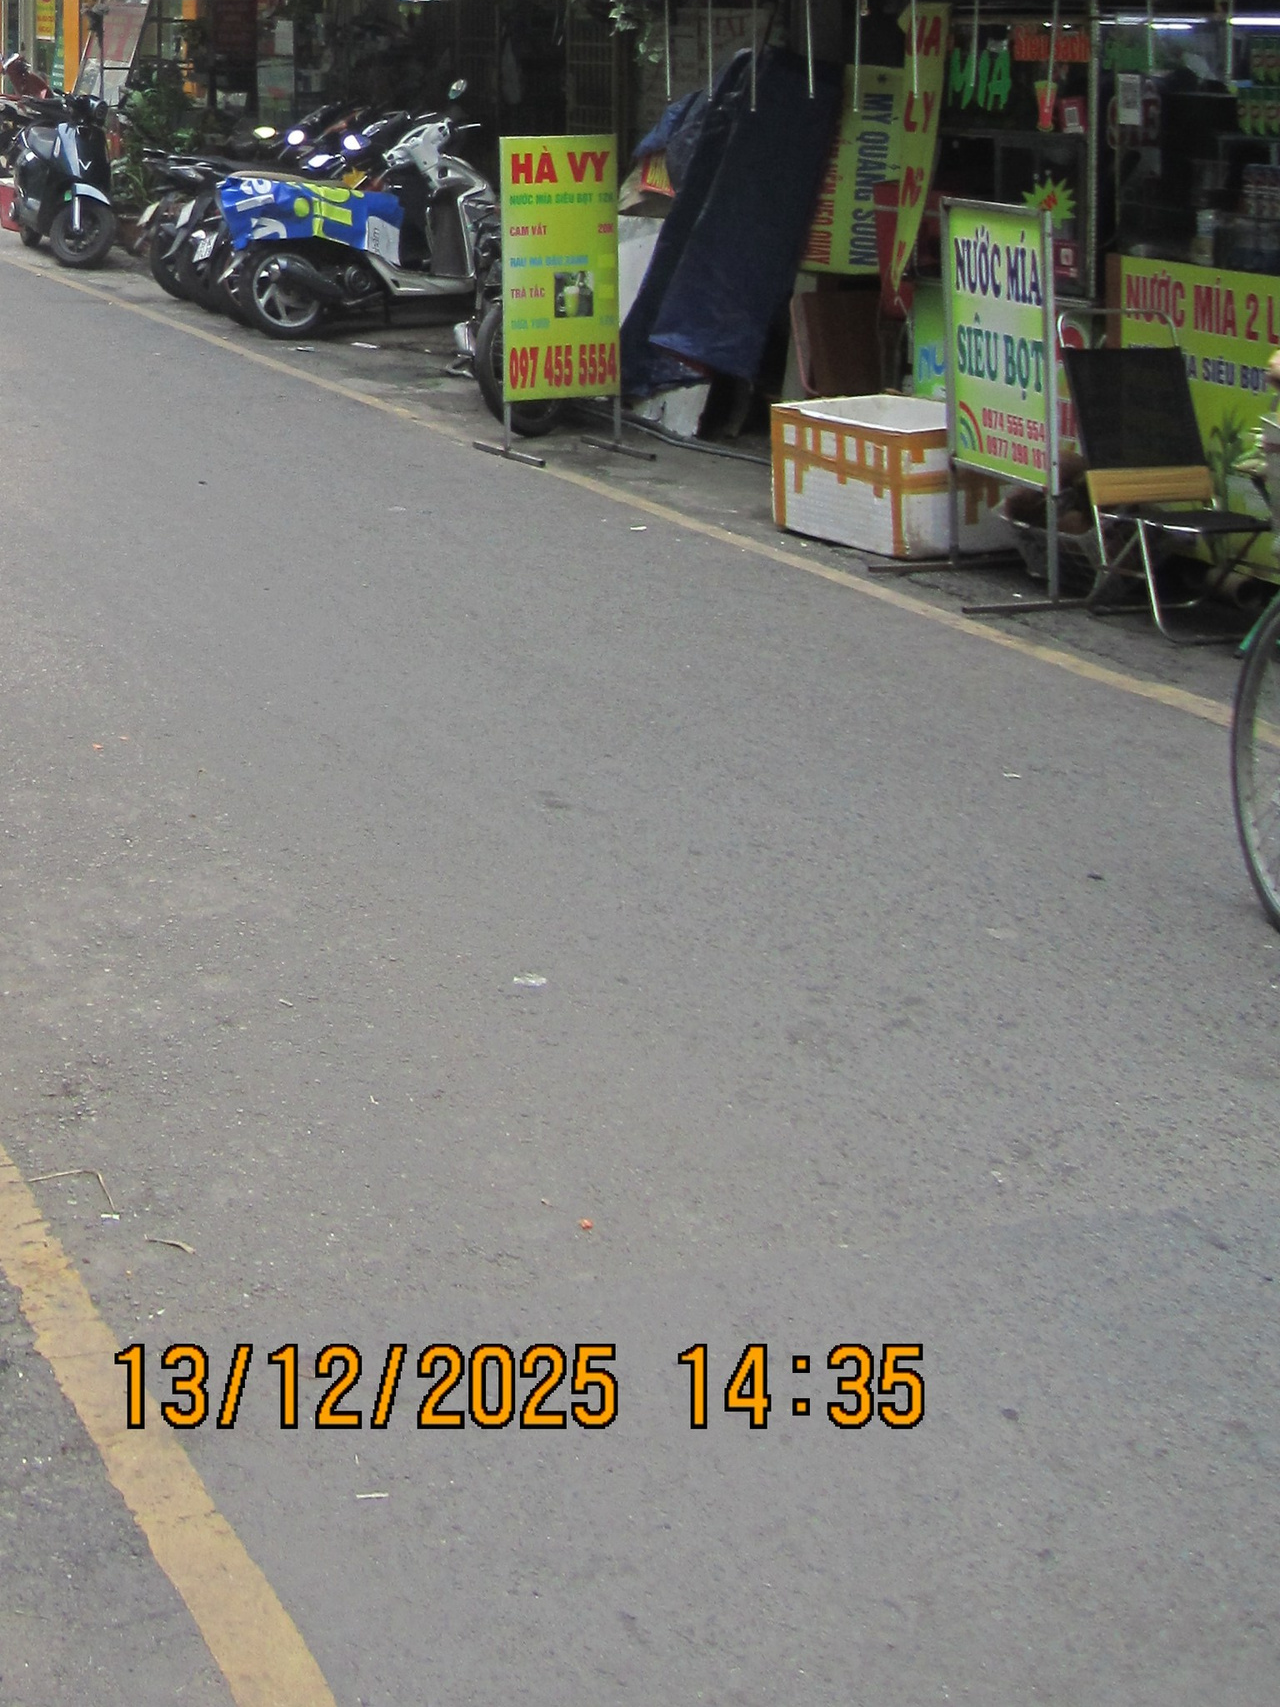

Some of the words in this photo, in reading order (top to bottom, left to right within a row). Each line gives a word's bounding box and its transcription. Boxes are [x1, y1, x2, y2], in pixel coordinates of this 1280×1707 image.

[511, 146, 558, 184] HÀ
[567, 151, 610, 183] VY
[510, 226, 529, 236] CAM
[954, 225, 1001, 298] NƯỚC
[1006, 231, 1043, 306] MÍA
[1126, 270, 1185, 328] NƯỚC
[1194, 278, 1238, 338] MÍA
[1245, 293, 1259, 342] 2
[510, 347, 539, 389] 097
[544, 345, 573, 387] 455
[578, 342, 617, 386] 5554
[957, 313, 998, 381] SIÊU
[1003, 334, 1044, 400] BỌT
